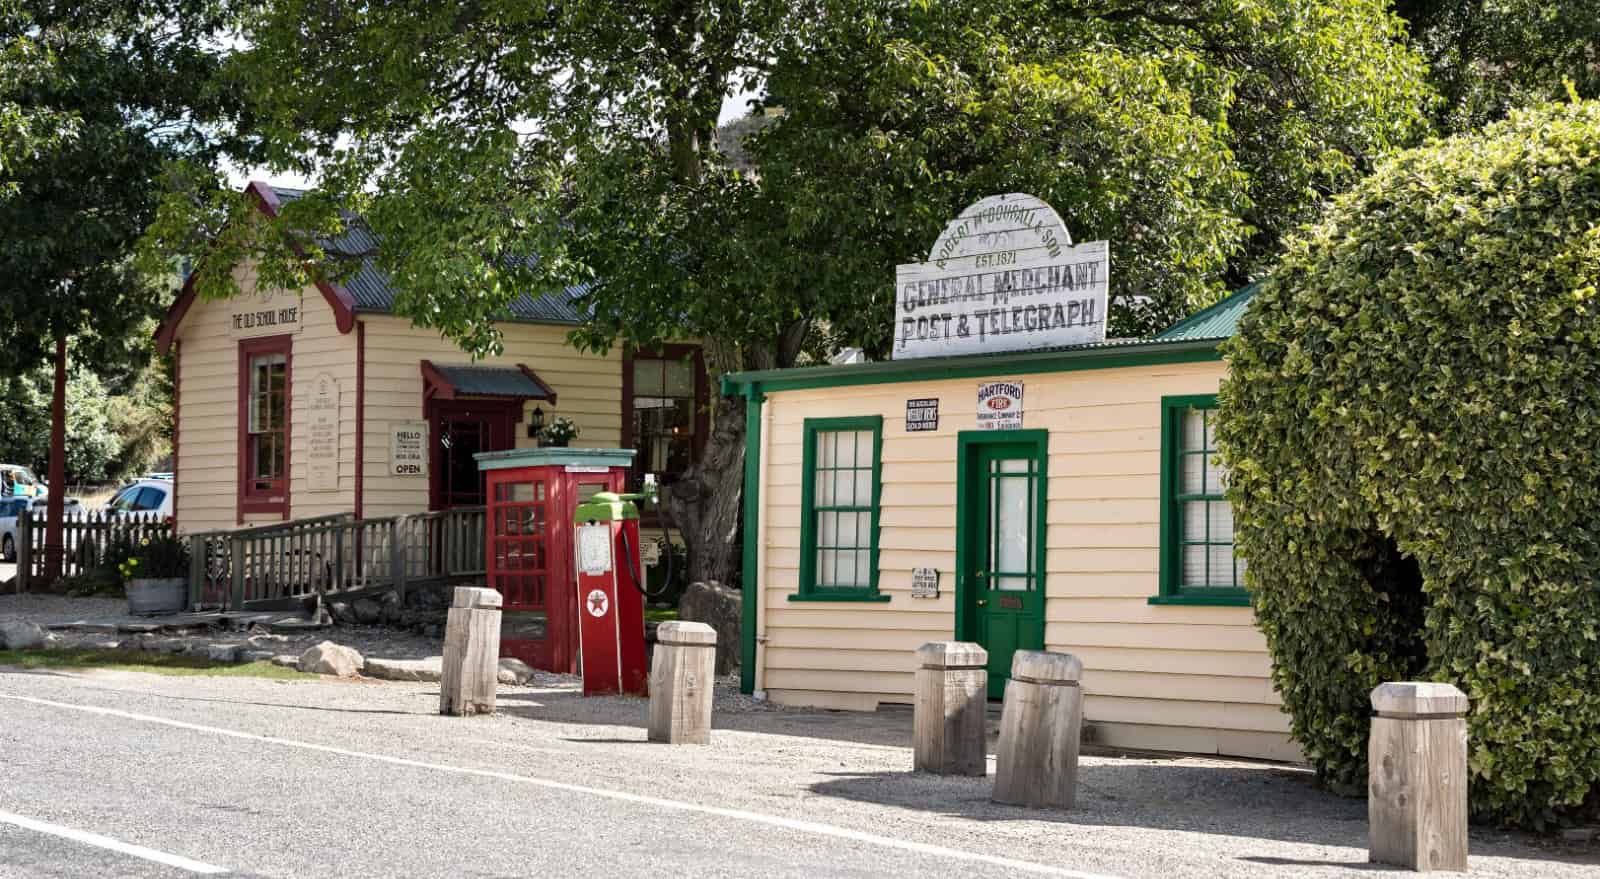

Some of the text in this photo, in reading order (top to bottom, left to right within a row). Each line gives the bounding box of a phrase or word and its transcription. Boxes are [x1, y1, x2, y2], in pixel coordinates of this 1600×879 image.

[935, 221, 970, 270] ROBERT
[1035, 220, 1043, 233] &
[1042, 229, 1061, 259] SON
[903, 261, 1100, 313] GENERAL MERCHANT
[232, 306, 298, 329] THE OLD SCHOOL HOUSE
[901, 299, 1096, 348] POST & TELEGRAPH
[978, 383, 1021, 404] HARTFORD
[991, 398, 1009, 409] FIRE
[396, 431, 421, 440] HELLO
[396, 464, 421, 474] OPEN
